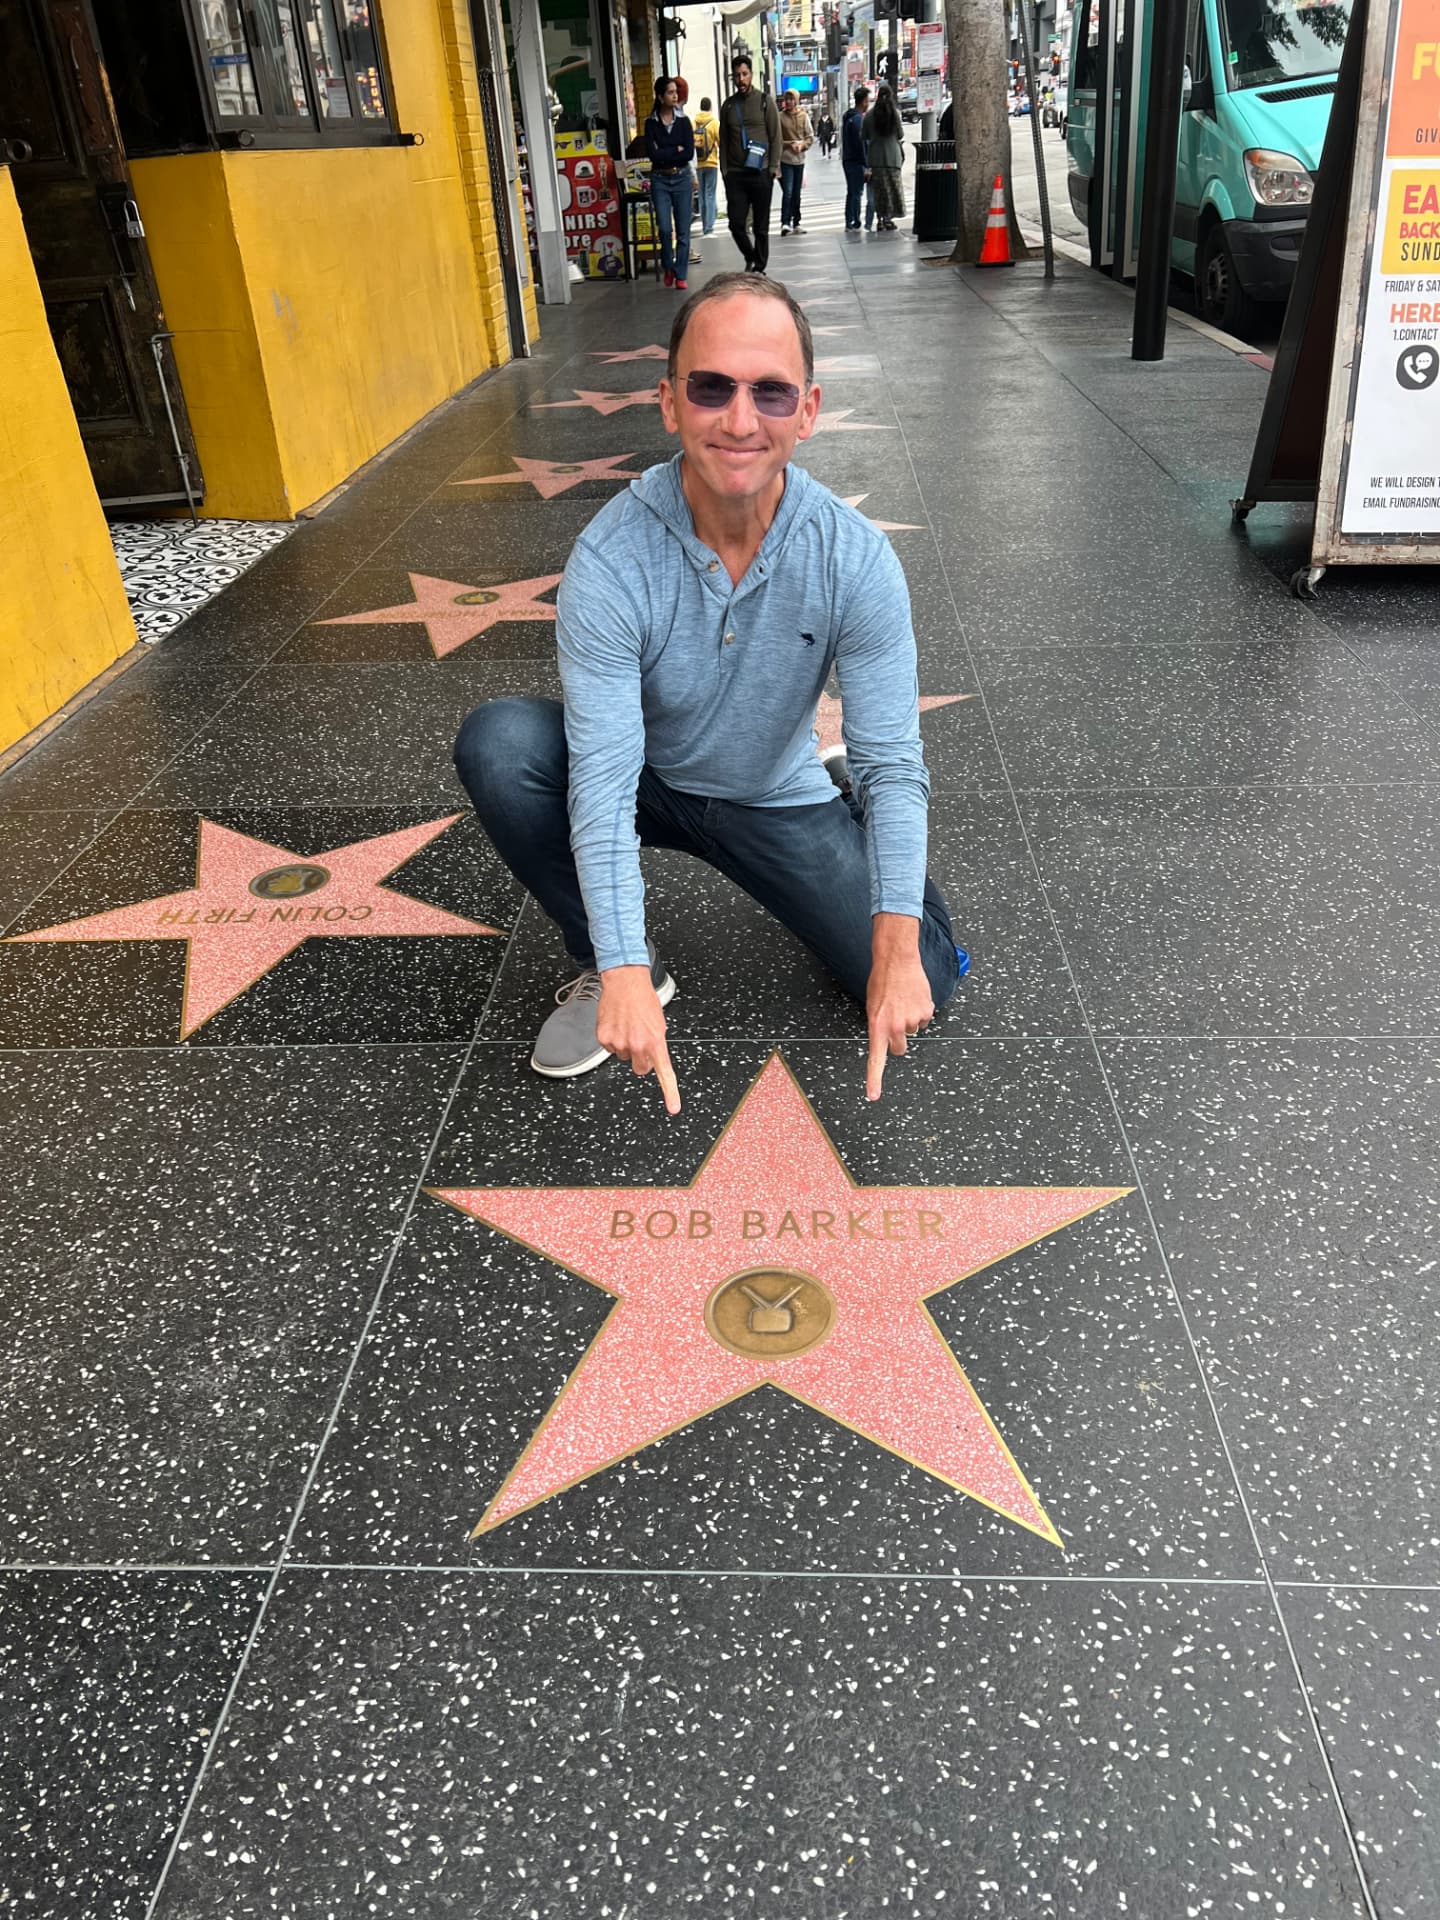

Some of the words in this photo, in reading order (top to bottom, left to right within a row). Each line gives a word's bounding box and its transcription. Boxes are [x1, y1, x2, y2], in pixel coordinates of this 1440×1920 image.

[1412, 42, 1440, 80] F
[1415, 128, 1440, 143] GIV
[564, 212, 609, 231] NIRS
[1399, 222, 1440, 239] BACK
[1385, 280, 1415, 292] FRIDAY
[1417, 280, 1423, 292] &
[1393, 328, 1439, 341] 1.CONTACT
[1370, 476, 1383, 488] WE
[1385, 476, 1404, 488] WILL
[1406, 476, 1436, 488] DESIGN
[1363, 497, 1387, 508] EMAIL
[156, 908, 256, 925] FIRTH
[268, 905, 373, 922] COLIN
[609, 1209, 713, 1240] BOB
[742, 1210, 946, 1240] BARKER
